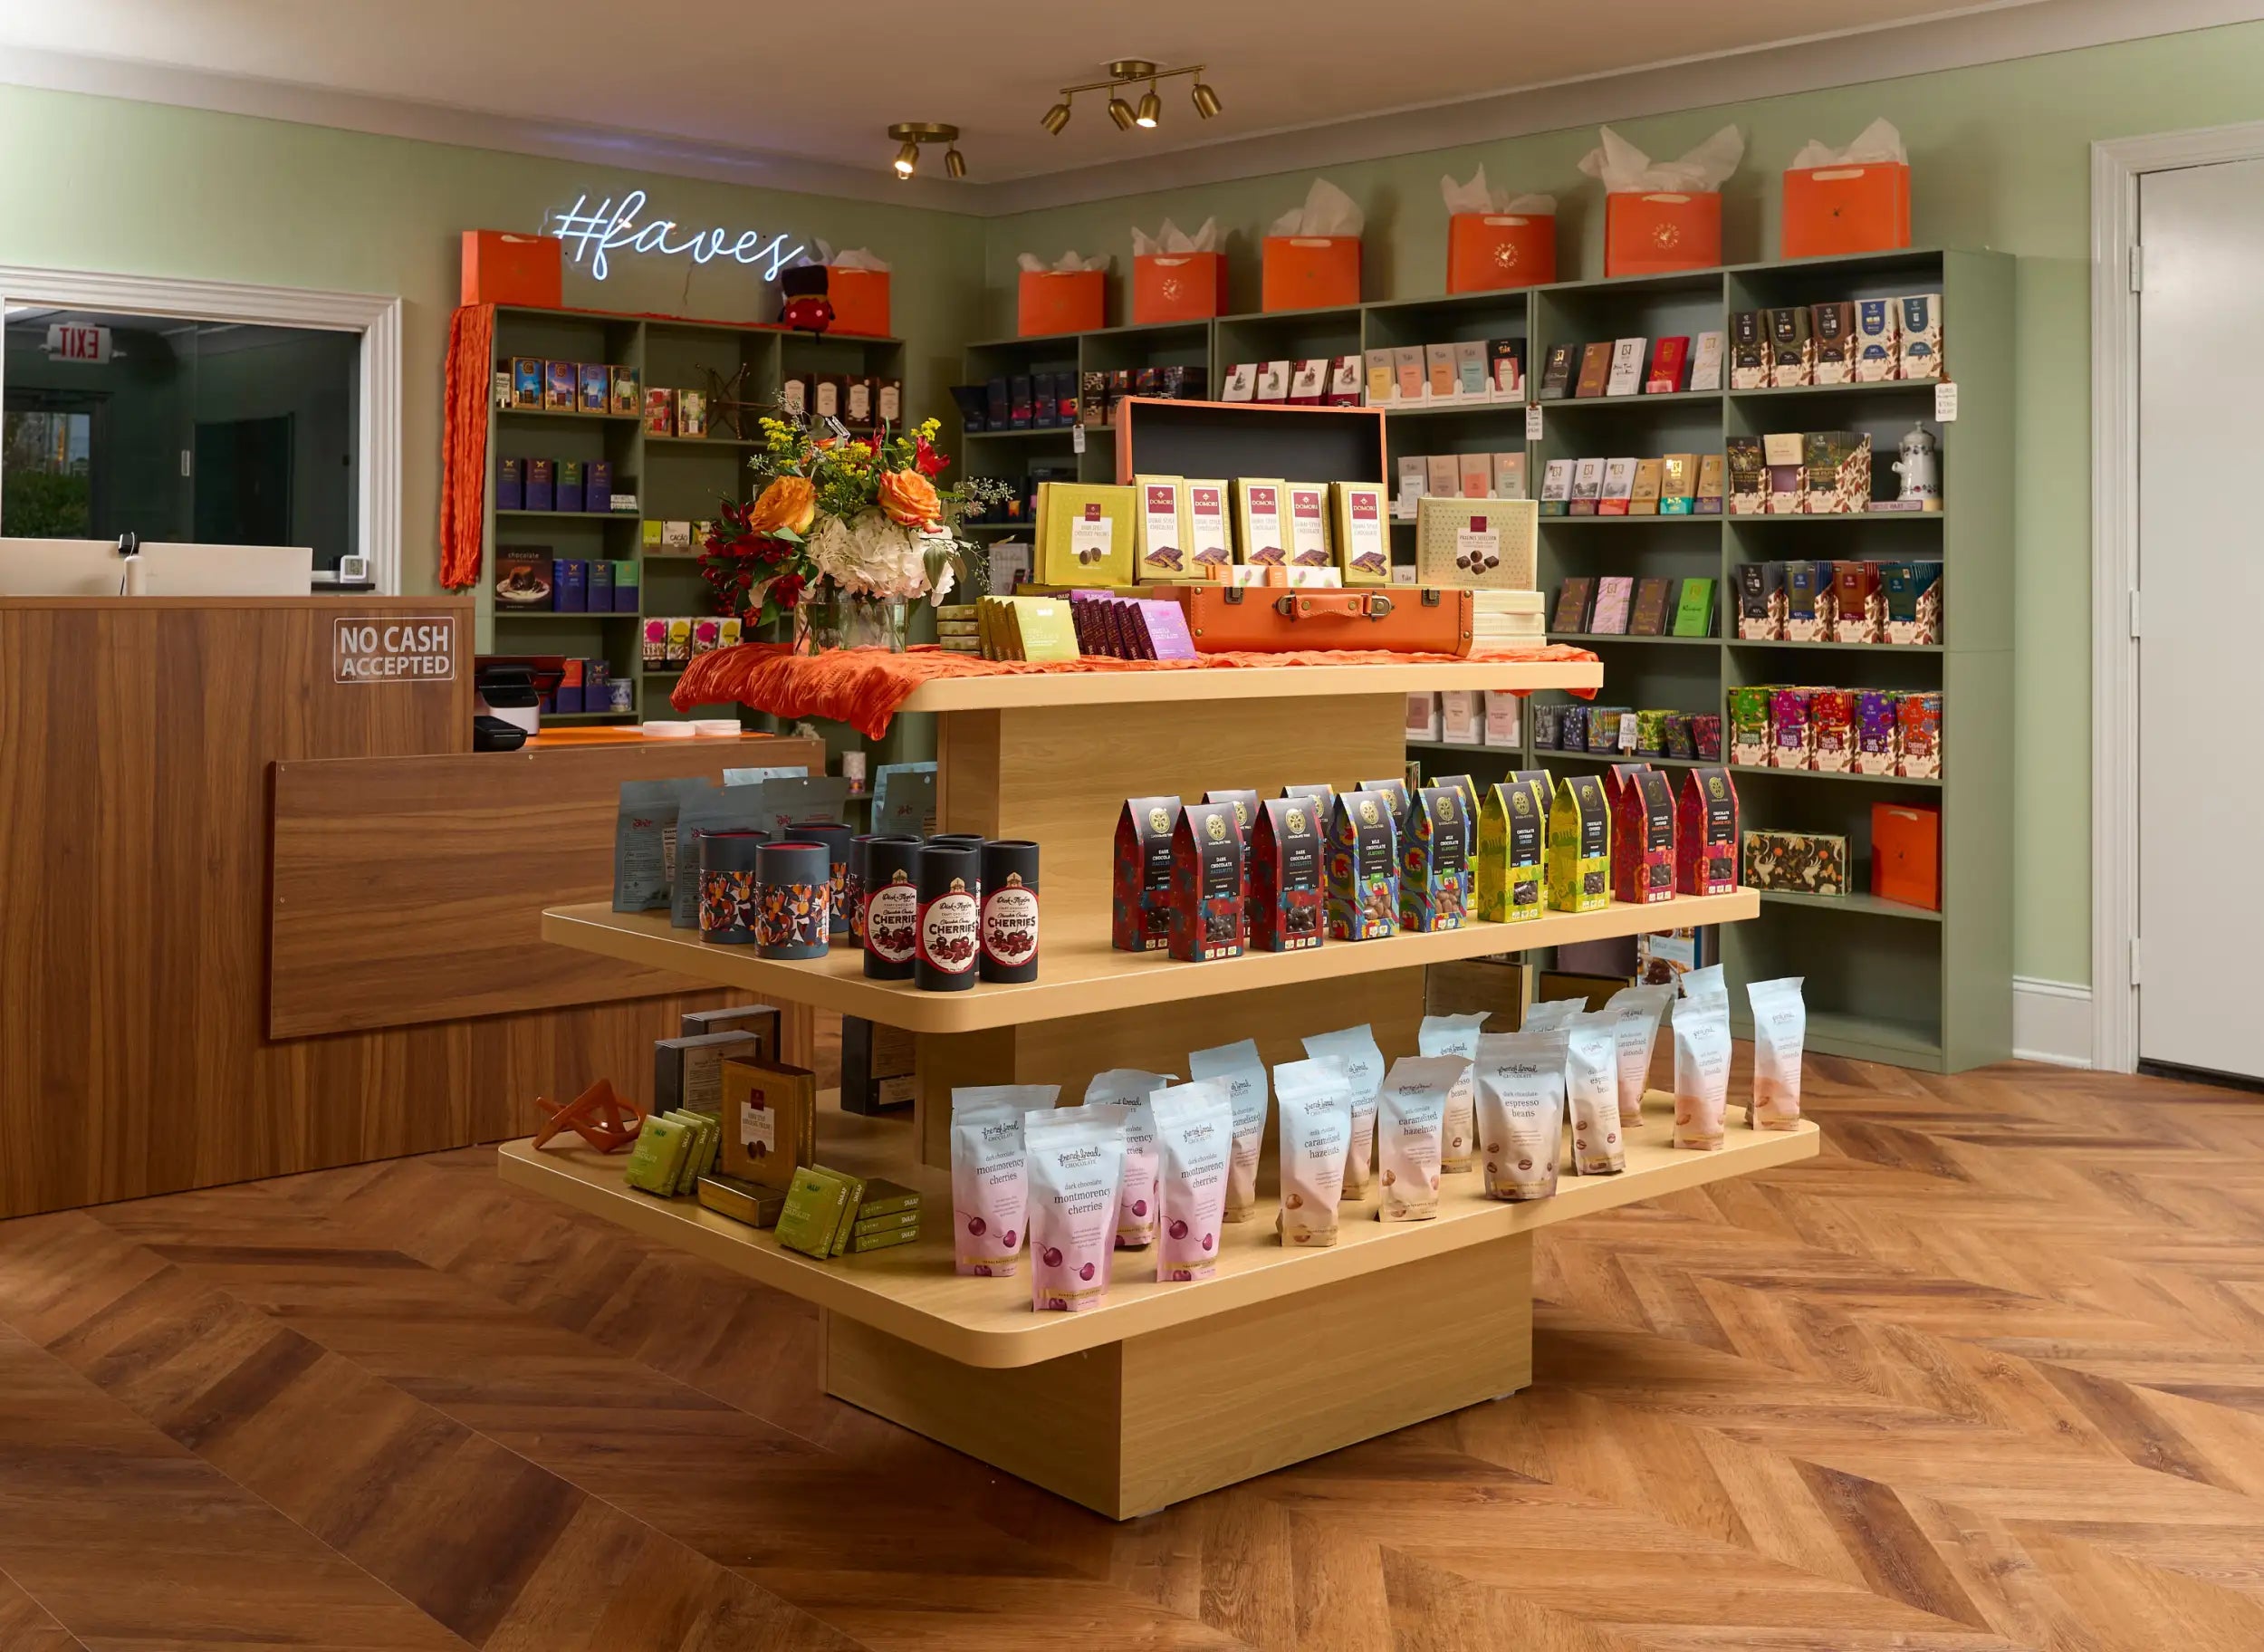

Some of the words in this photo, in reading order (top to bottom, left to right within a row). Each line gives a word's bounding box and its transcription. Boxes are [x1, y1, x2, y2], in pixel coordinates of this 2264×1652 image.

[552, 191, 804, 281] #faves
[1295, 502, 1318, 510] DOMORI
[507, 551, 540, 560] chocolate
[341, 626, 378, 653] NO
[384, 626, 448, 652] CASH
[341, 656, 450, 676] ACCEPTED
[883, 893, 898, 903] Dick
[997, 896, 1012, 905] Dick
[940, 902, 956, 910] Dick
[873, 914, 916, 924] CHERRIE
[988, 917, 1035, 927] CHERRIES
[929, 922, 975, 935] CHERRIES
[1505, 1100, 1539, 1108] espresso
[1233, 1112, 1261, 1127] ramelized
[1511, 1109, 1535, 1118] beans
[1404, 1124, 1436, 1136] hazelnuts
[1127, 1133, 1153, 1143] orency
[1058, 1151, 1079, 1167] french
[1079, 1147, 1100, 1158] broad
[976, 1158, 1024, 1176] montmorency
[1065, 1159, 1096, 1168] CHOCOLATE
[1181, 1161, 1224, 1178] montmorency
[990, 1172, 1017, 1185] cherries
[1065, 1181, 1076, 1190] dark
[1078, 1179, 1102, 1188] chocolate
[1193, 1175, 1218, 1188] cherries
[1054, 1187, 1111, 1204] montmorency
[1068, 1201, 1103, 1215] cherries
